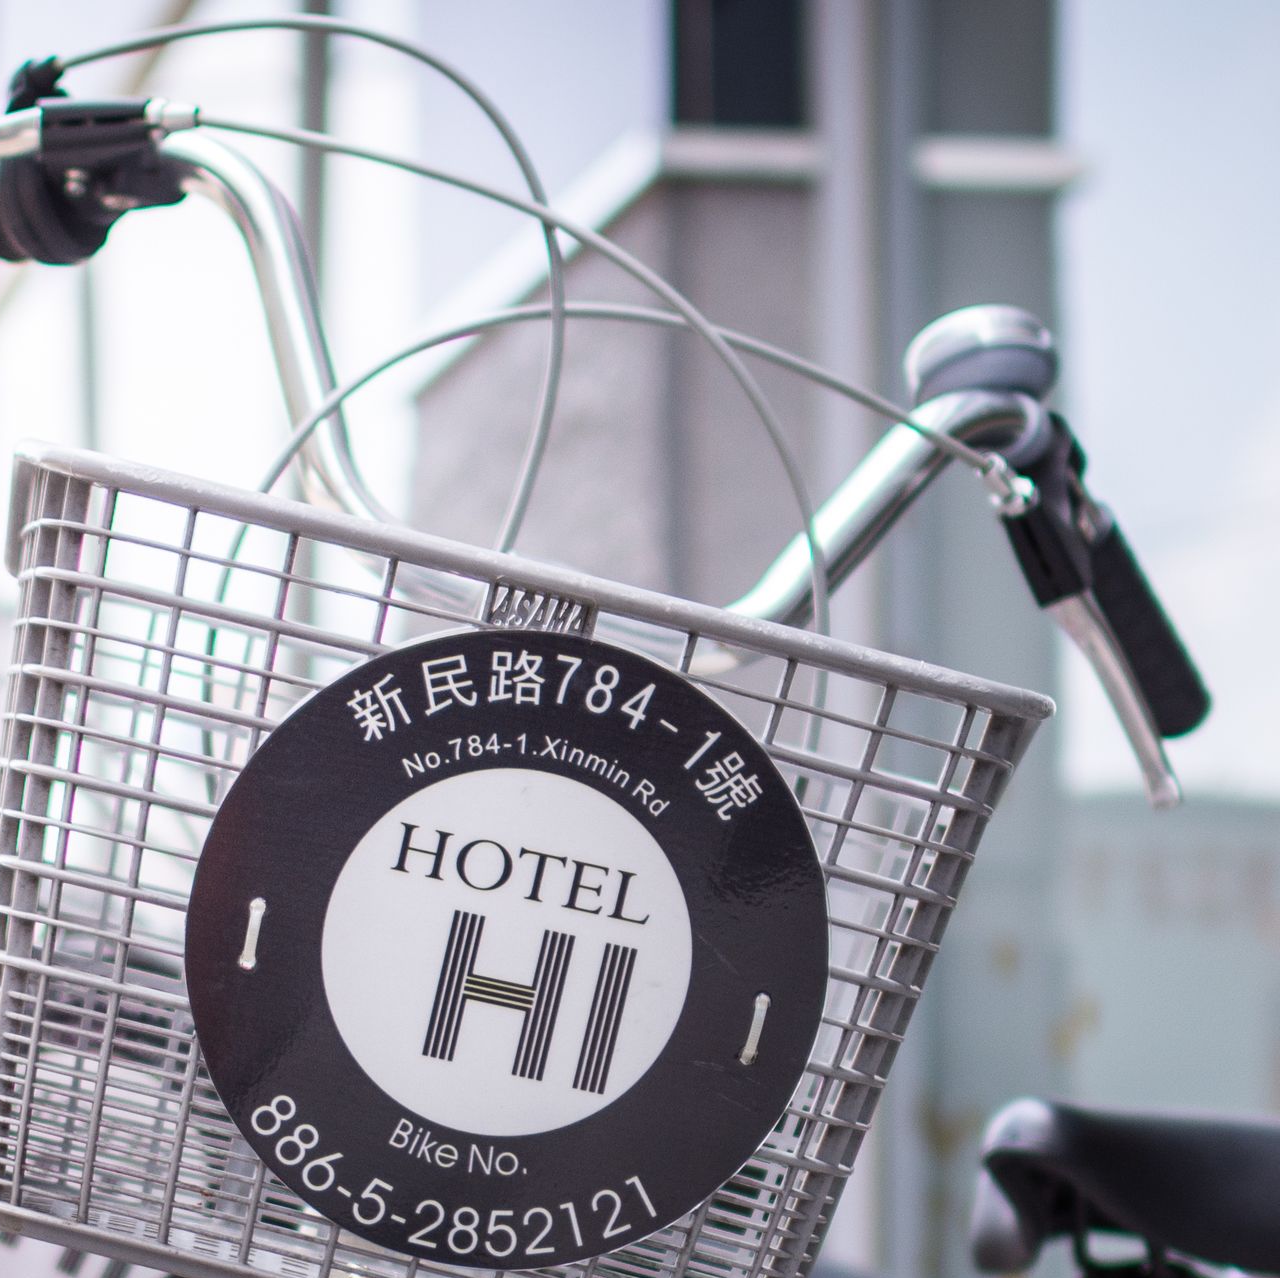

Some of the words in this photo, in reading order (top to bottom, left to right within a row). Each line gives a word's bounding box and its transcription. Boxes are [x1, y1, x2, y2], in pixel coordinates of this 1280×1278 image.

[346, 649, 764, 822] 新民路784-1號
[401, 732, 633, 789] No.784-1.Xinmin
[631, 777, 671, 818] Rd
[390, 821, 650, 926] HOTEL
[421, 909, 638, 1095] HI
[250, 1094, 658, 1257] 886-5-2852121
[388, 1117, 459, 1168] Bike
[467, 1143, 528, 1176] No.
